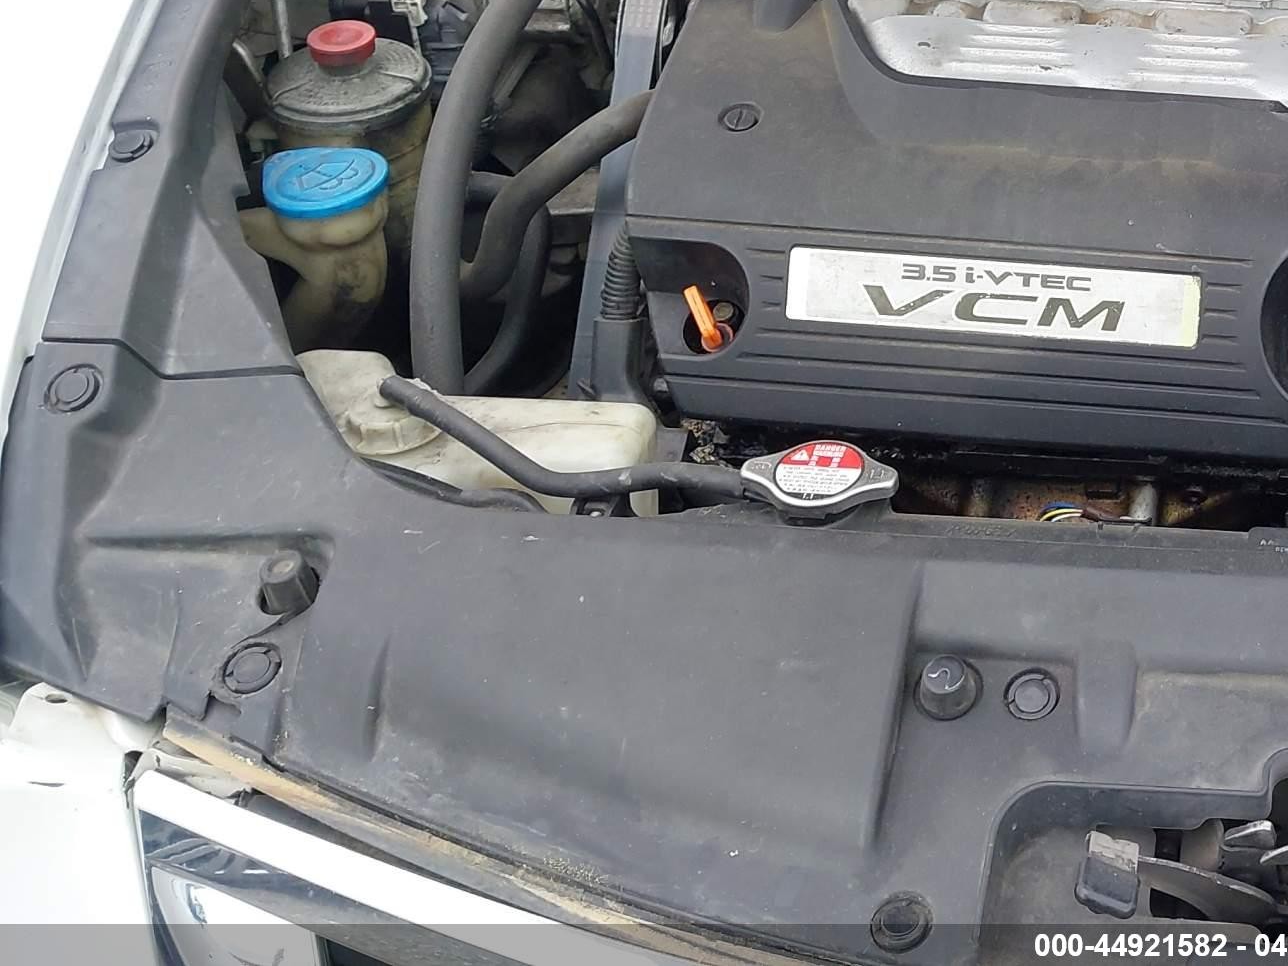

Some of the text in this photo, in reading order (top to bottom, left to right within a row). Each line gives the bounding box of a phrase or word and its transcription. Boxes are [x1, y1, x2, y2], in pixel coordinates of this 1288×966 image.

[901, 263, 1092, 292] 3.5 i-VTEC
[863, 284, 1125, 332] VCM
